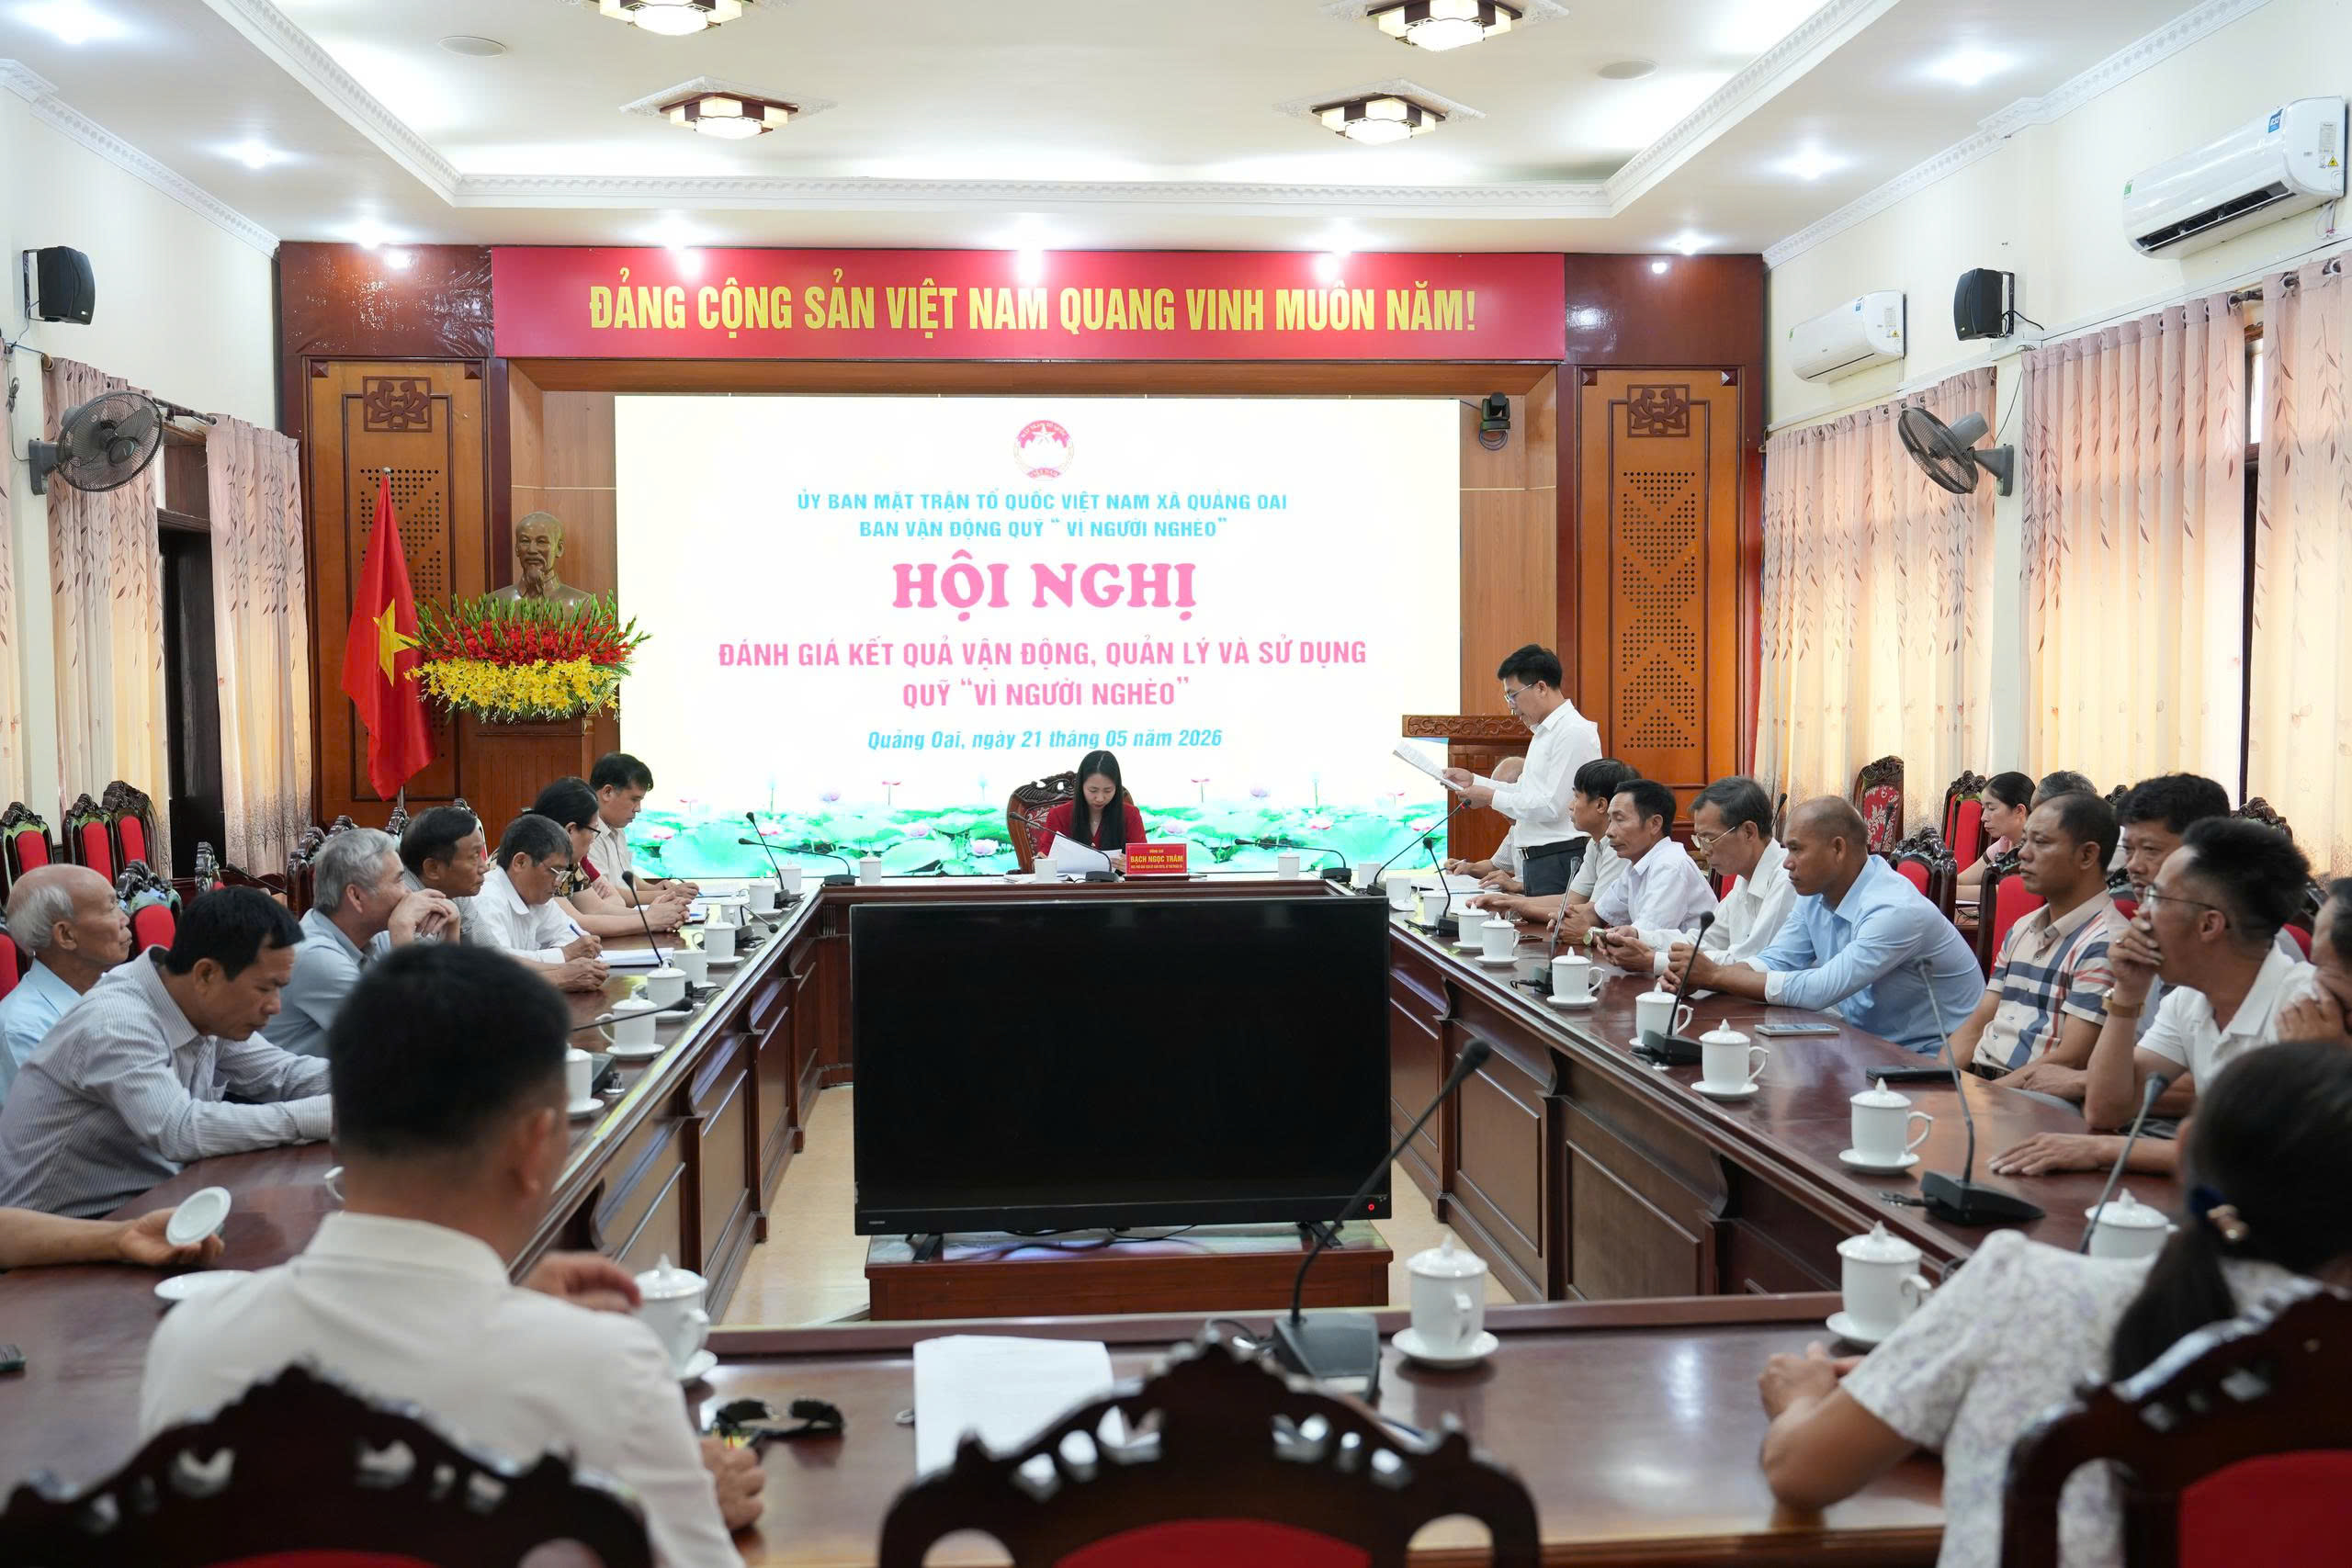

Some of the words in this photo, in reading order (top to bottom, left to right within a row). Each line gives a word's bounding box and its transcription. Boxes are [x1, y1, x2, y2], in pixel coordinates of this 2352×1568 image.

[590, 267, 686, 329] ĐẢNG
[697, 276, 792, 339] CỘNG
[804, 267, 875, 329] SẢN
[886, 277, 958, 339] VIỆT
[969, 288, 1048, 329] NAM
[1059, 288, 1175, 334] QUANG
[1185, 288, 1264, 331] VINH
[1275, 281, 1375, 331] MUÔN
[1386, 279, 1477, 331] NĂM!
[797, 488, 821, 510] ỦY
[828, 493, 868, 510] BAN
[873, 491, 914, 513] MẶT
[920, 491, 970, 513] TRẬN
[977, 488, 1000, 511] TỔ
[1004, 489, 1056, 512] QUỐC
[1061, 491, 1101, 513] VIỆT
[1105, 493, 1151, 510] NAM
[1157, 491, 1182, 510] XÃ
[1186, 489, 1251, 512] QUẢNG
[1256, 493, 1287, 510] OAI
[859, 521, 899, 537] BAN
[905, 518, 944, 540] VẬN
[949, 518, 1002, 540] ĐỘNG
[1008, 518, 1044, 539] QUỸ
[1067, 518, 1084, 537] VÌ
[1090, 517, 1148, 537] NGƯỜI
[892, 548, 1010, 622] HỘI
[1030, 562, 1196, 622] NGHỊ
[718, 638, 789, 666] ĐÁNH
[797, 638, 840, 666] GIÁ
[848, 636, 894, 666] KẾT
[903, 635, 954, 668] QUẢ
[962, 637, 1012, 671] VẬN
[1021, 637, 1096, 671] ĐỘNG,
[1105, 634, 1174, 667] QUẢN
[1182, 637, 1210, 665] LÝ
[1218, 637, 1250, 665] VÀ
[1259, 633, 1294, 665] SỬ
[1300, 640, 1366, 669] DỤNG
[903, 679, 950, 709] QUỸ
[1006, 677, 1081, 706] NGƯỜI
[867, 728, 925, 750] Quảng
[931, 730, 967, 750] Oai,
[972, 730, 1015, 750] ngày
[1022, 730, 1043, 748] 21
[1048, 728, 1101, 750] tháng
[1105, 730, 1127, 748] 05
[1133, 728, 1172, 748] năm
[1177, 728, 1223, 748] 2026
